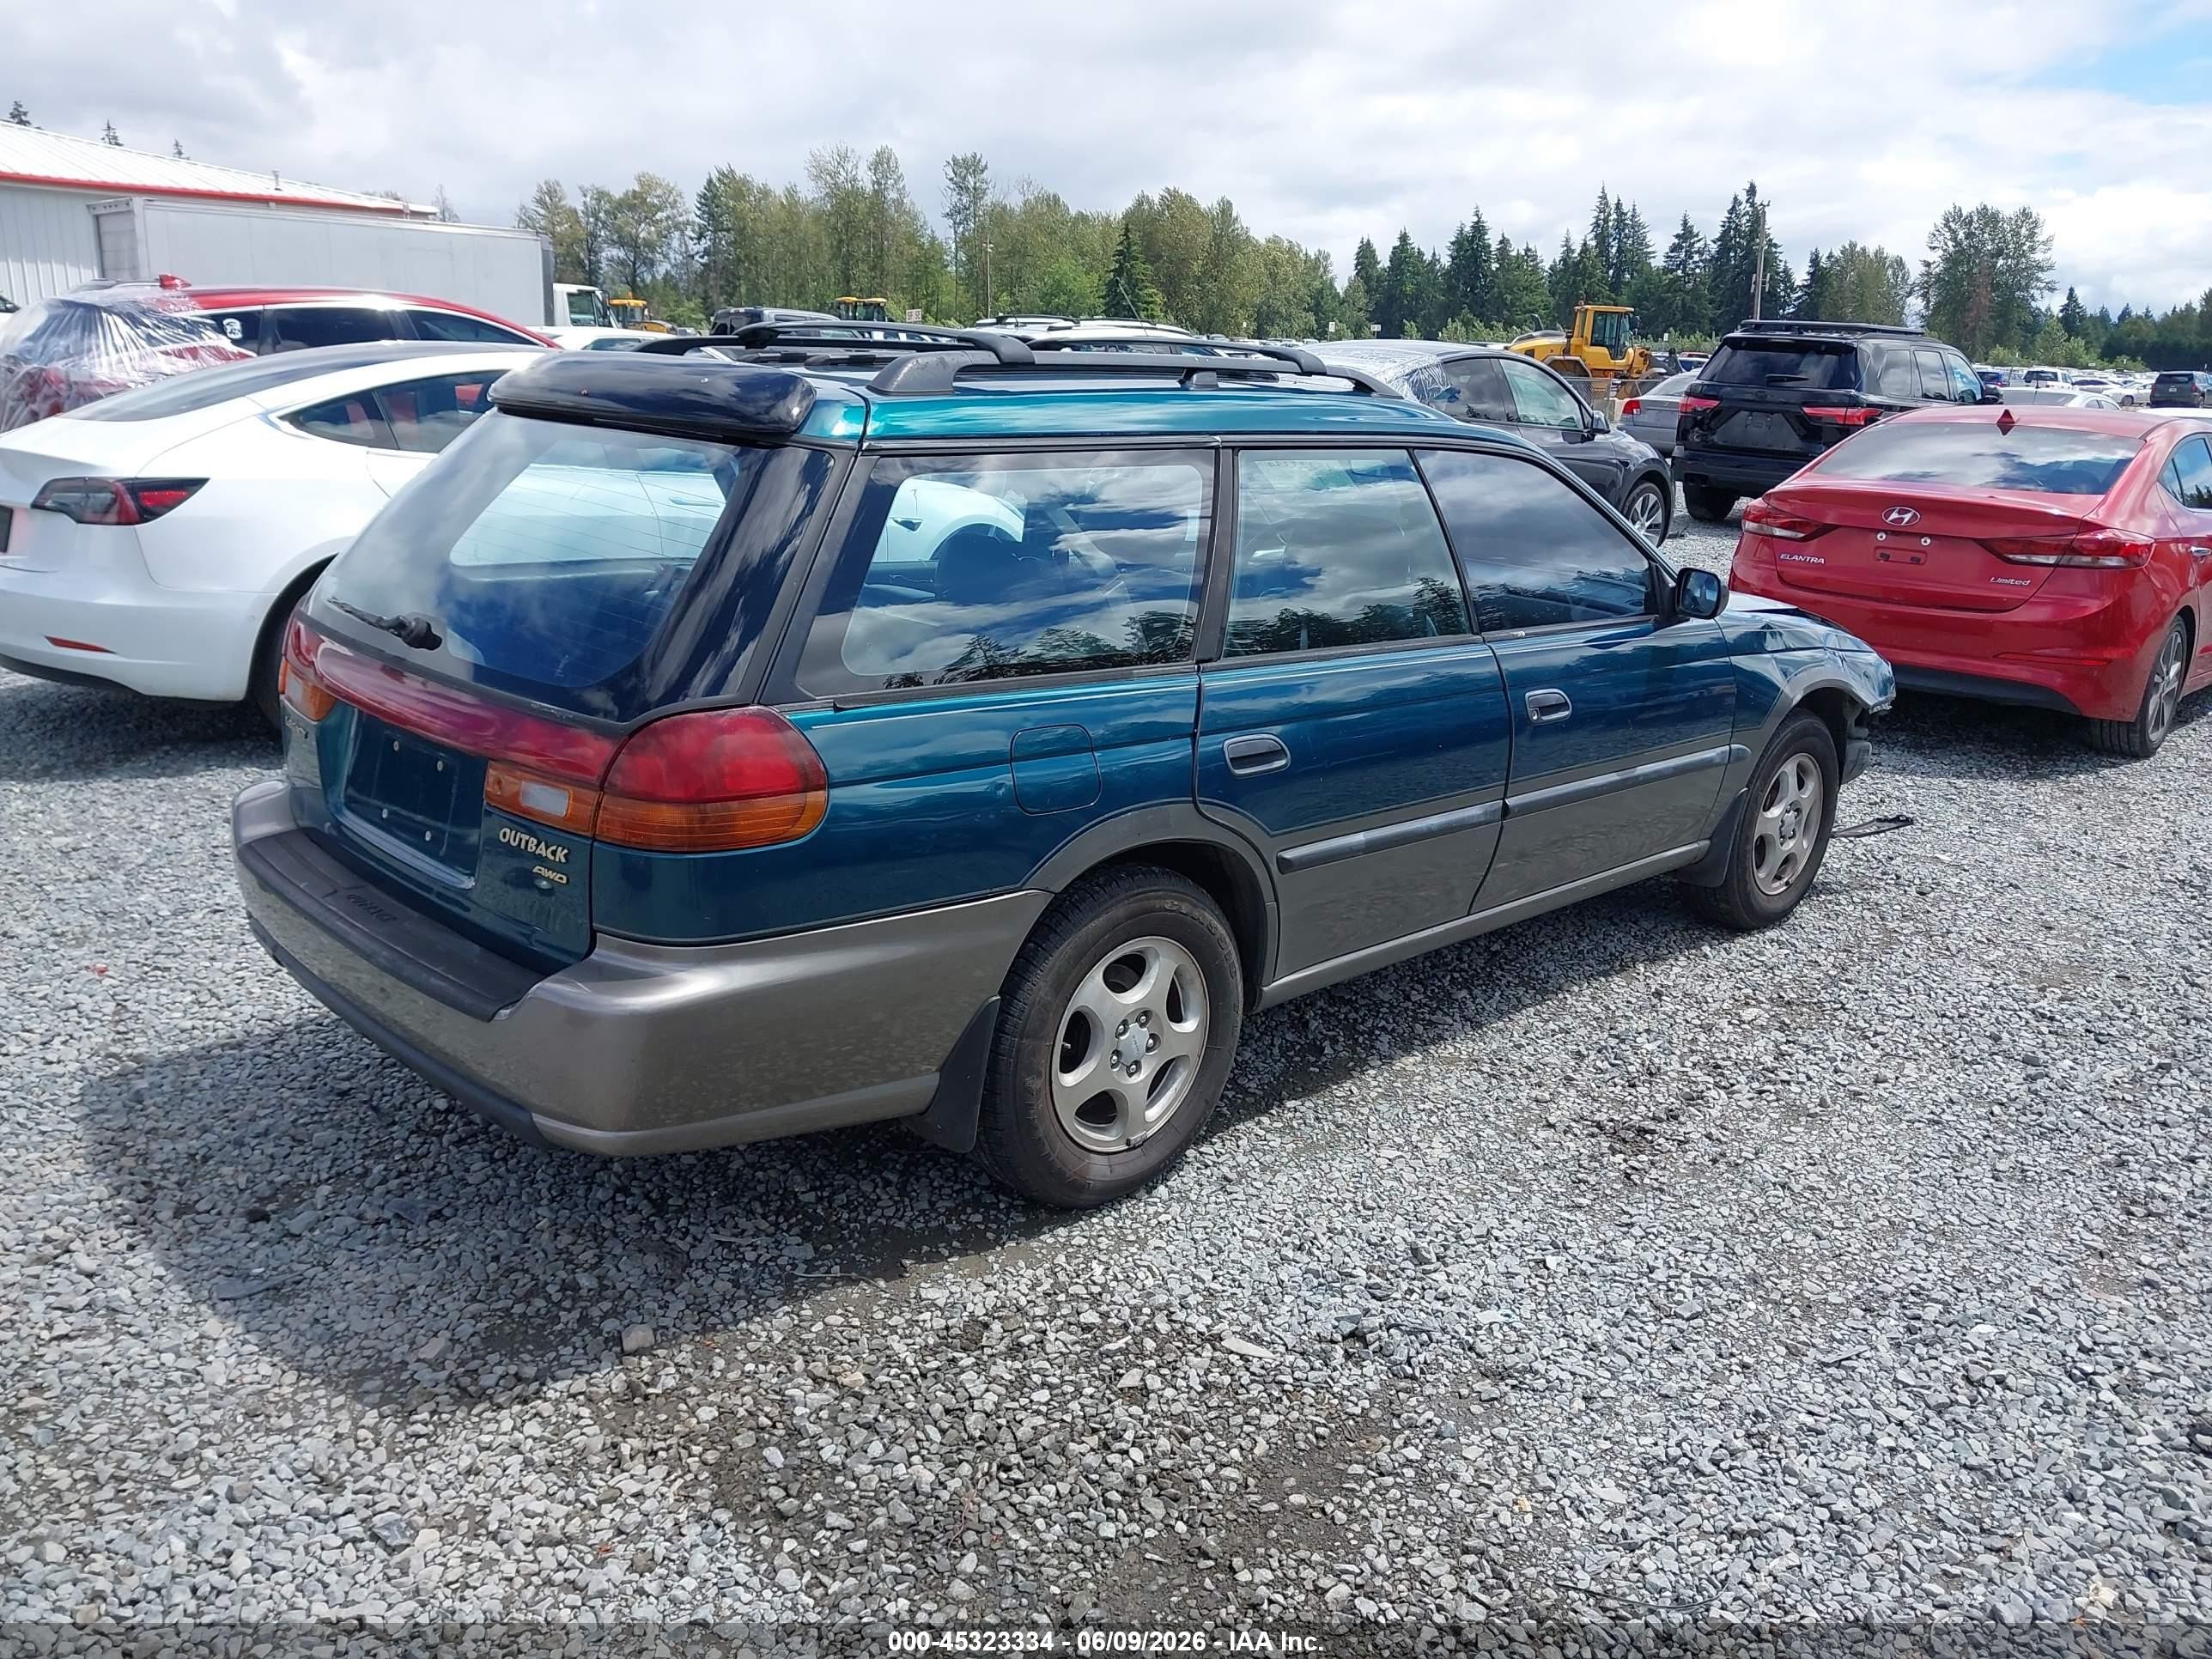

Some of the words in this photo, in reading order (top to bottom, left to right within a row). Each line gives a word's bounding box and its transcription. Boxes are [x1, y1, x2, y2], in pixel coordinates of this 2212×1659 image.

[1779, 553, 1825, 564] ELANTRA
[1990, 576, 2032, 586] Limited
[499, 827, 568, 863] OUTBACK
[532, 865, 568, 884] AWD
